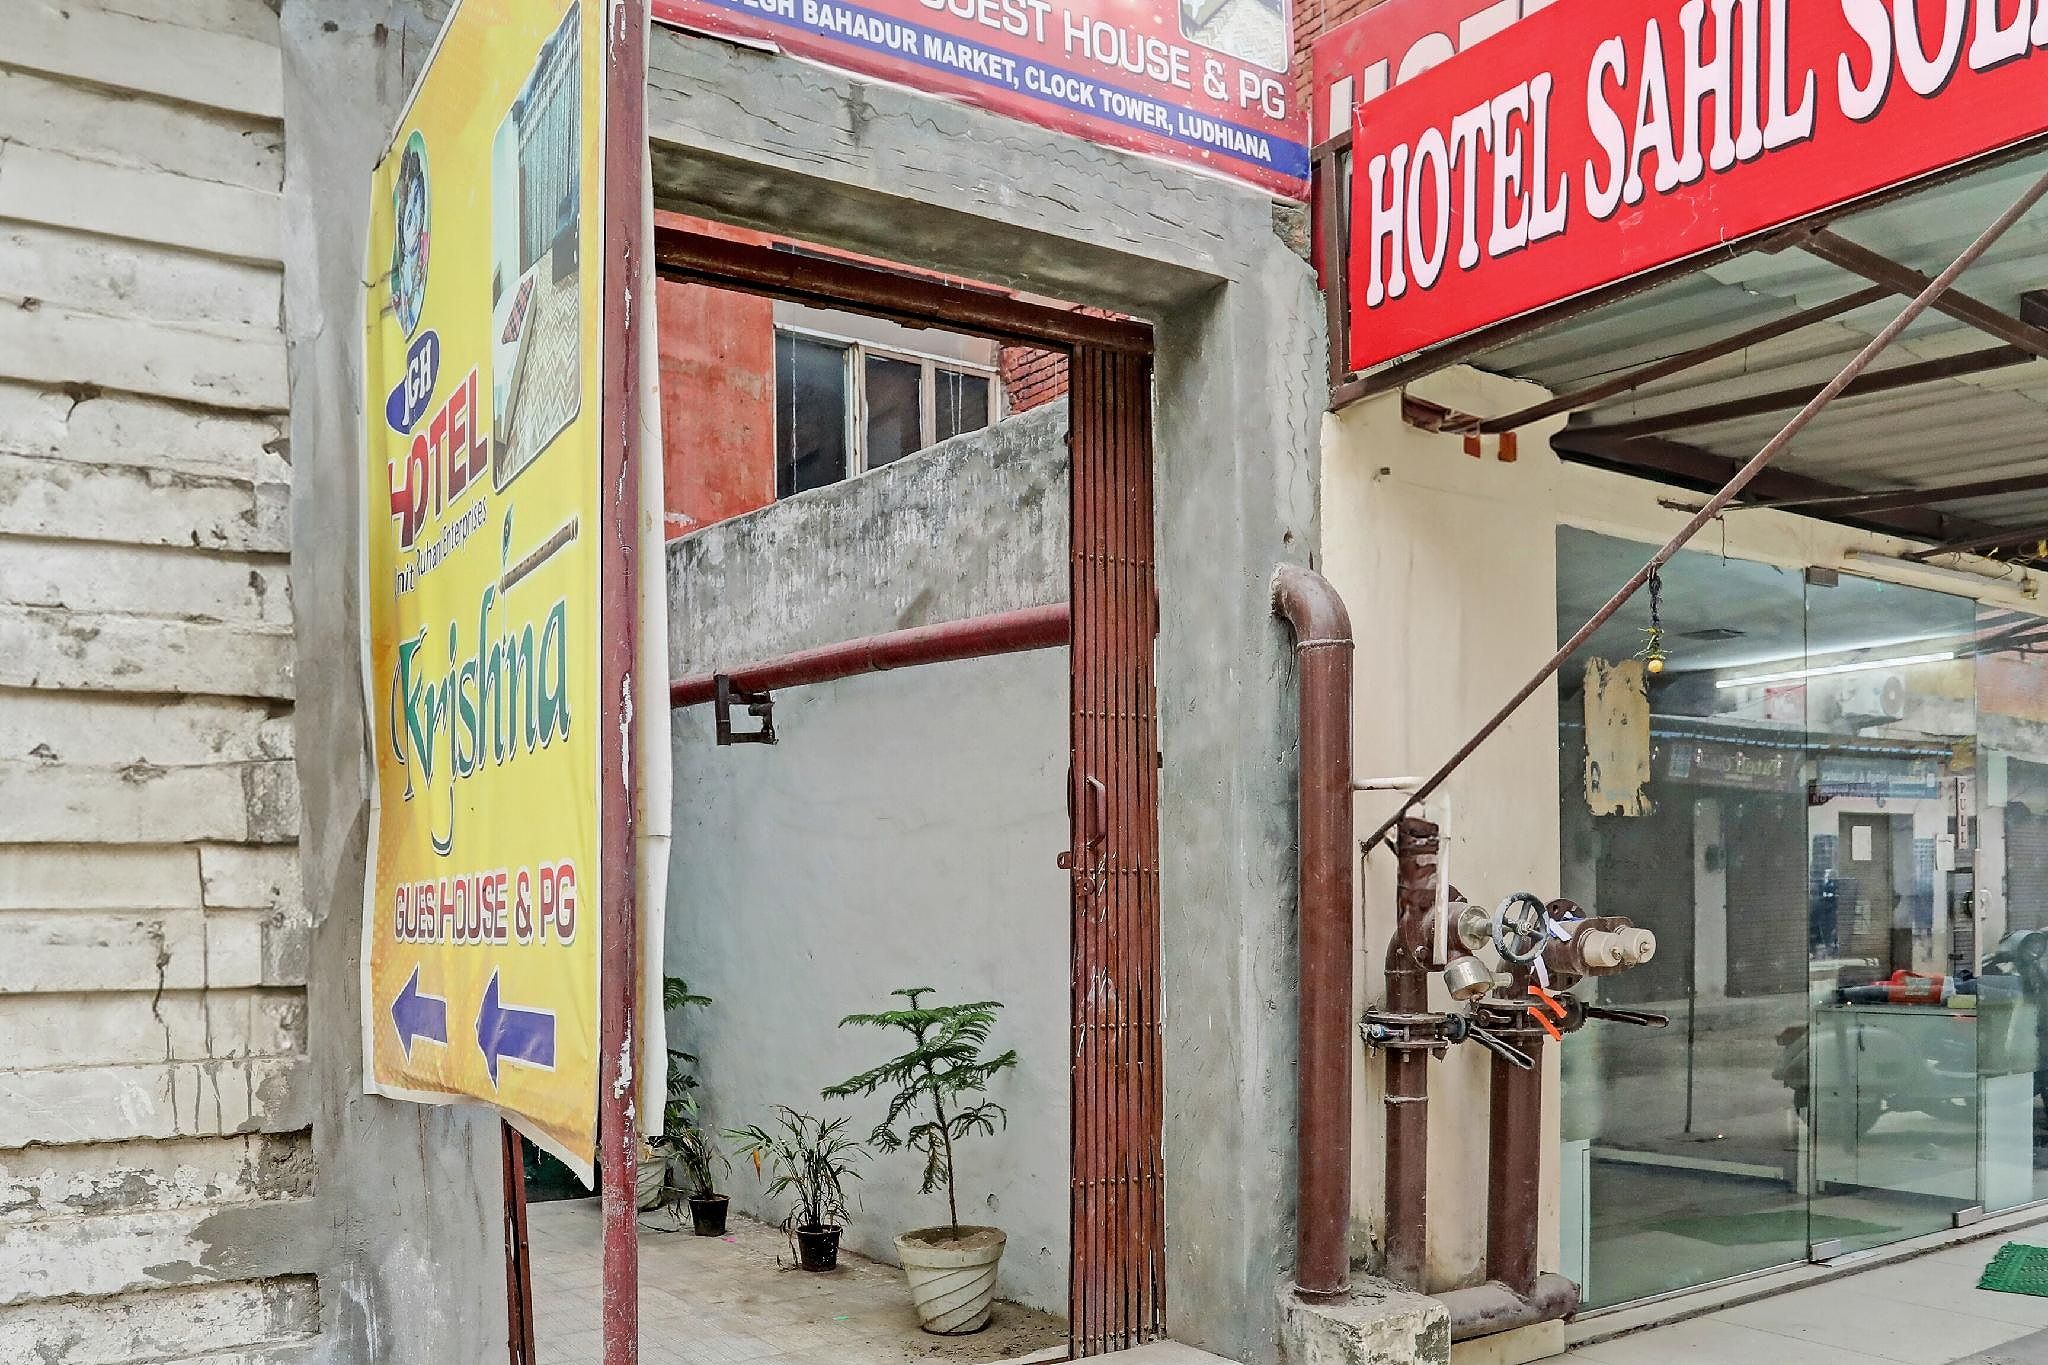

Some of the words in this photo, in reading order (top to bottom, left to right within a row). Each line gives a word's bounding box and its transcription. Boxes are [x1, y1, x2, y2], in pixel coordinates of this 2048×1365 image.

[802, 0, 918, 55] BAHADUR
[924, 34, 1019, 90] MARKET,
[1025, 66, 1096, 108] CLOCK
[1100, 89, 1173, 136] TOWER,
[1178, 112, 1272, 162] LUDHIANA
[920, 0, 1053, 43] EST
[1063, 9, 1192, 90] HOUSE
[1203, 58, 1229, 101] &
[1238, 68, 1286, 120] PG
[1367, 71, 1567, 307] HOTEL
[1586, 0, 1817, 220] SAHIL
[388, 367, 488, 550] HOTEL
[442, 495, 487, 557] Enterprises
[391, 583, 571, 856] Krishna
[1959, 782, 1967, 843] PULL
[438, 868, 508, 943] HOUSE
[515, 866, 533, 943] &
[538, 858, 576, 945] PG
